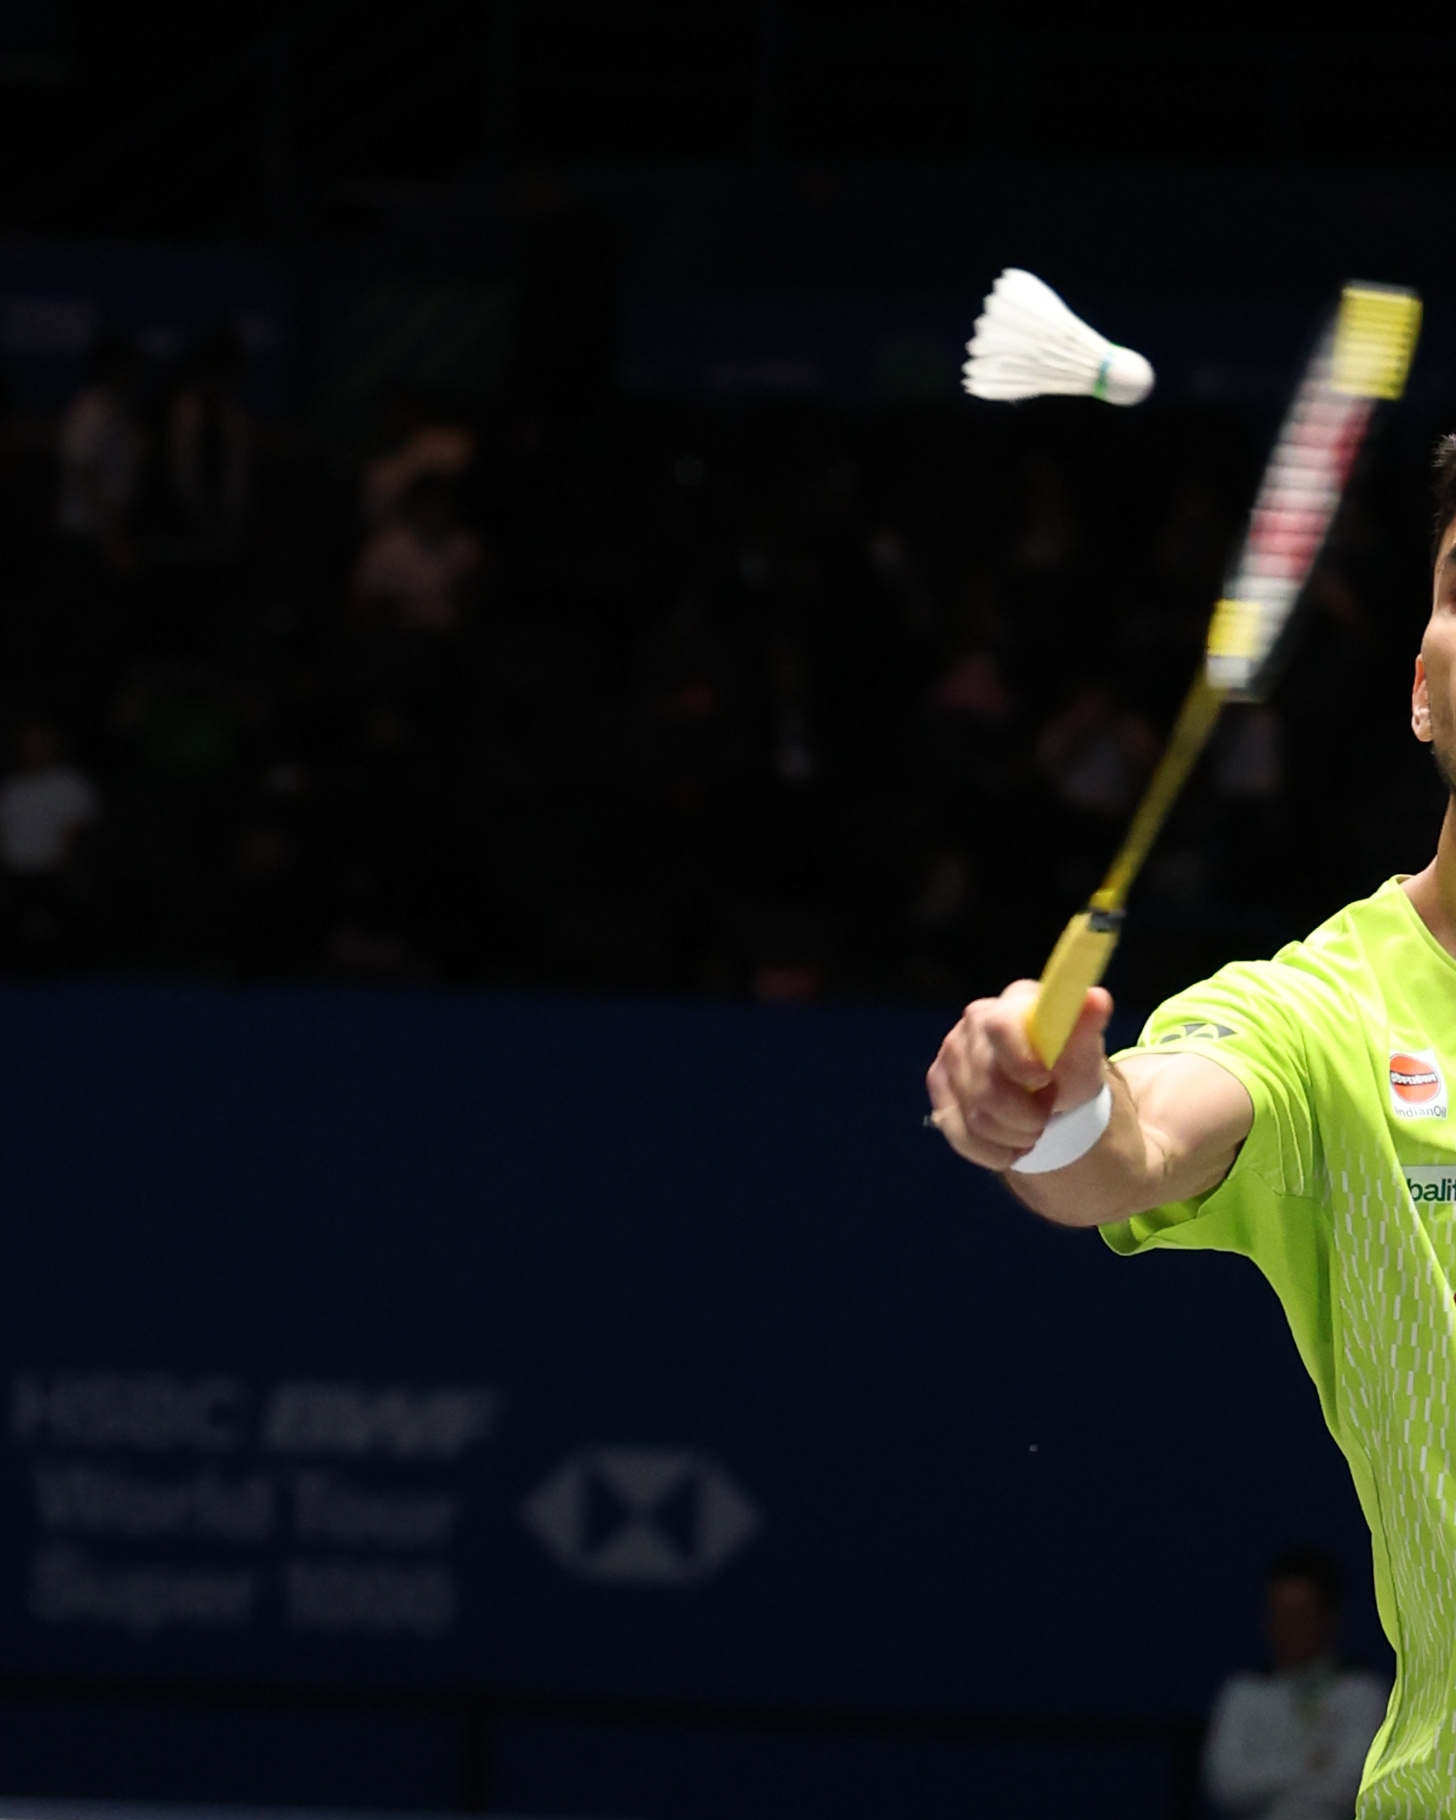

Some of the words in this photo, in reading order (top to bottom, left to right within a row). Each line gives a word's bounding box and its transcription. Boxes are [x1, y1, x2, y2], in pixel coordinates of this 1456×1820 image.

[1394, 1105, 1447, 1118] IndianOil
[10, 1372, 245, 1451] HSBC
[31, 1457, 277, 1541] World
[292, 1463, 460, 1549] Tour
[28, 1540, 254, 1638] Super
